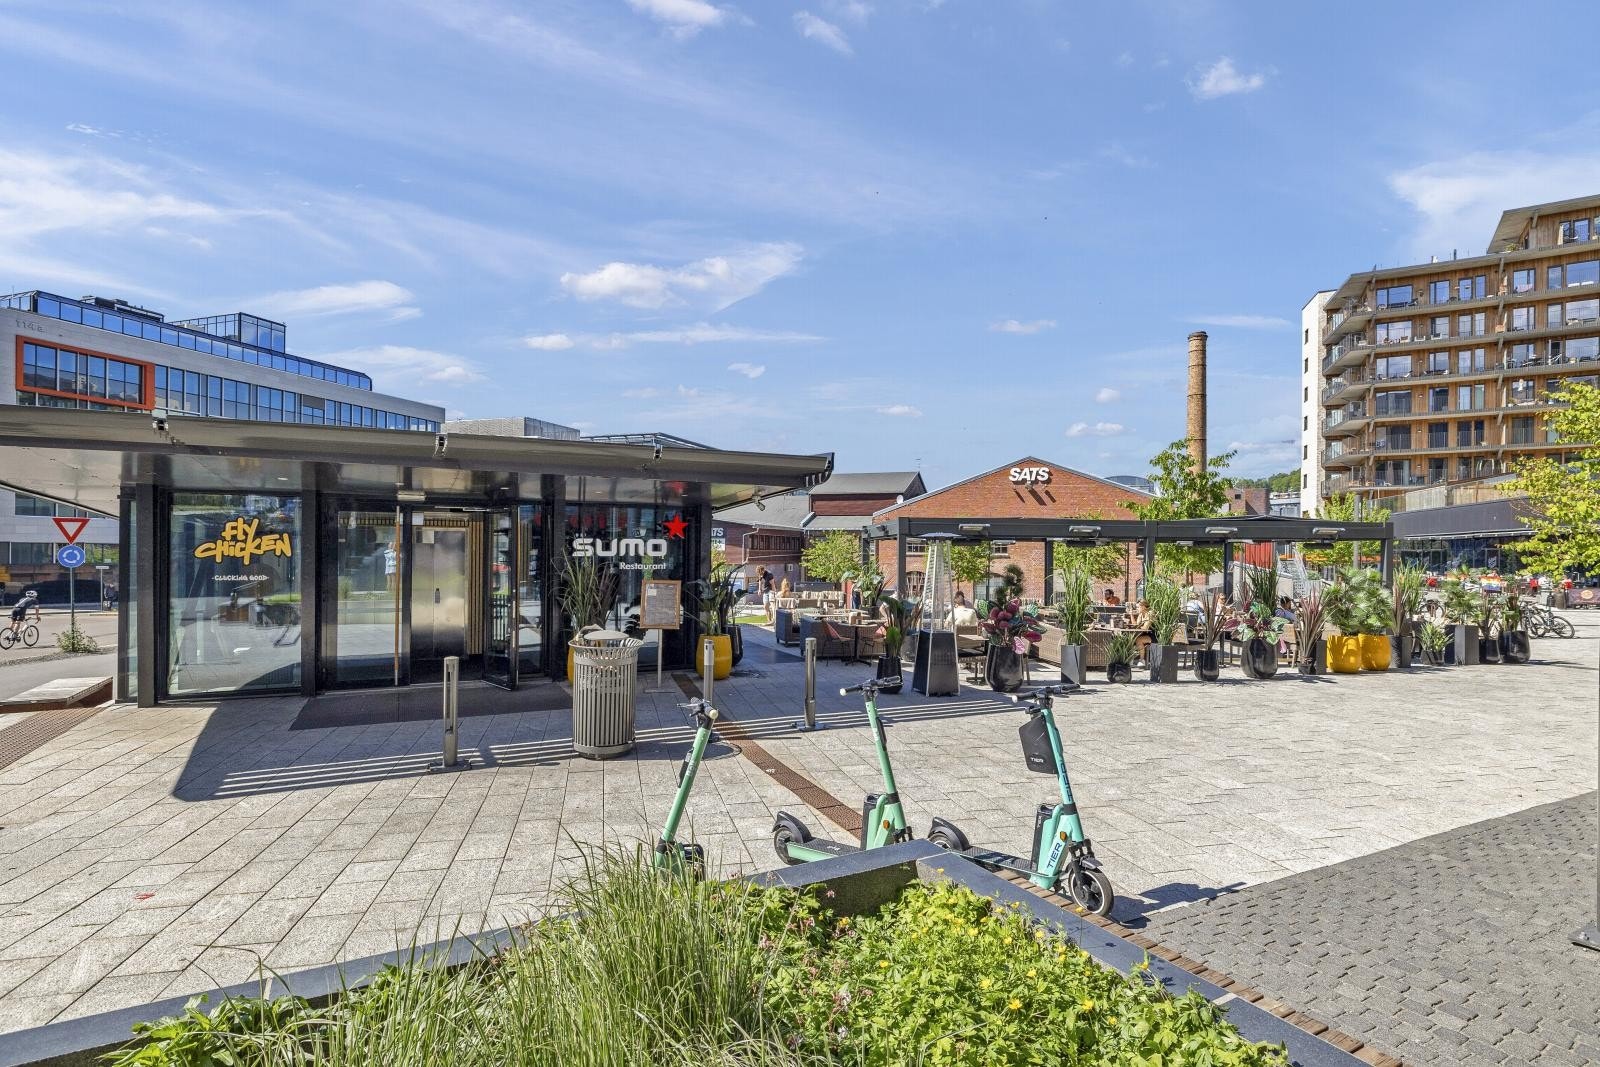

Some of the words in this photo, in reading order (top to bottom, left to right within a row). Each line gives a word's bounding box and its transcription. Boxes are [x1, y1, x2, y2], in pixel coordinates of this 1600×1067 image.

[1009, 467, 1050, 481] SATS
[620, 562, 666, 570] Restaurant
[1046, 842, 1063, 869] TIER
